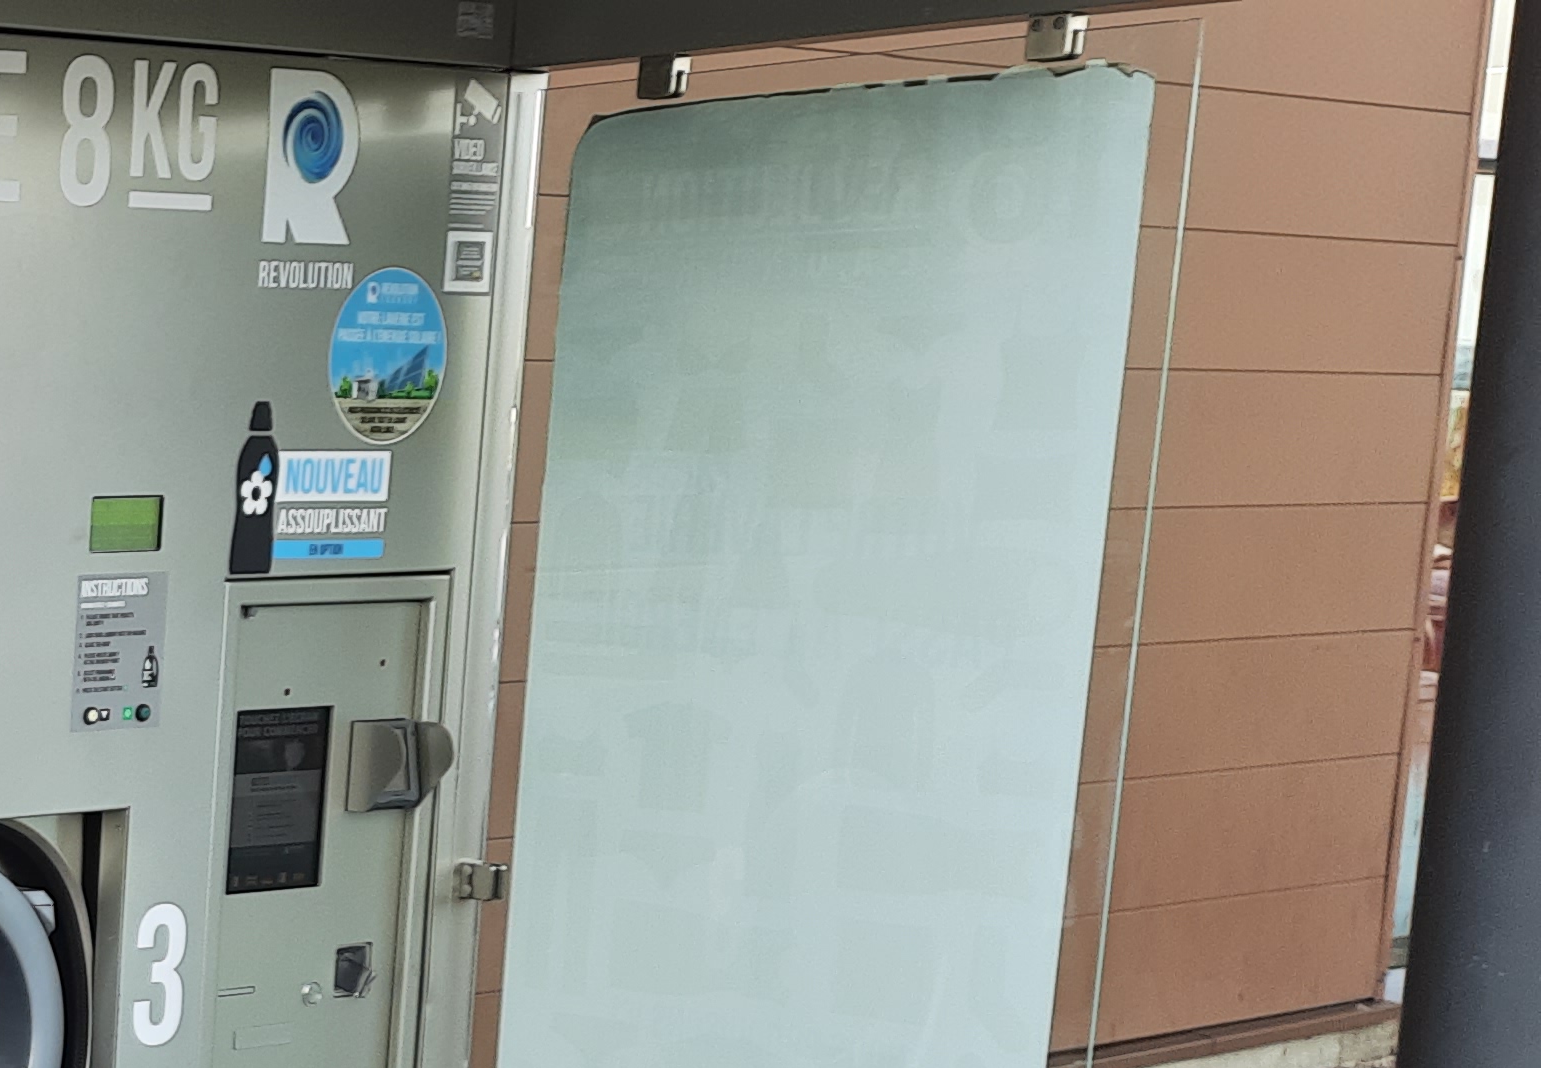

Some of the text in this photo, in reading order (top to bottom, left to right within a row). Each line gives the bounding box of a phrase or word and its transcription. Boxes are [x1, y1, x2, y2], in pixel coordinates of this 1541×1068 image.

[59, 54, 115, 207] 8
[129, 59, 220, 181] KG
[258, 260, 354, 289] REVOLUTION
[285, 458, 384, 494] NOUVEAU
[277, 508, 388, 533] ASSOUPLISSANT
[131, 902, 187, 1046] 3
